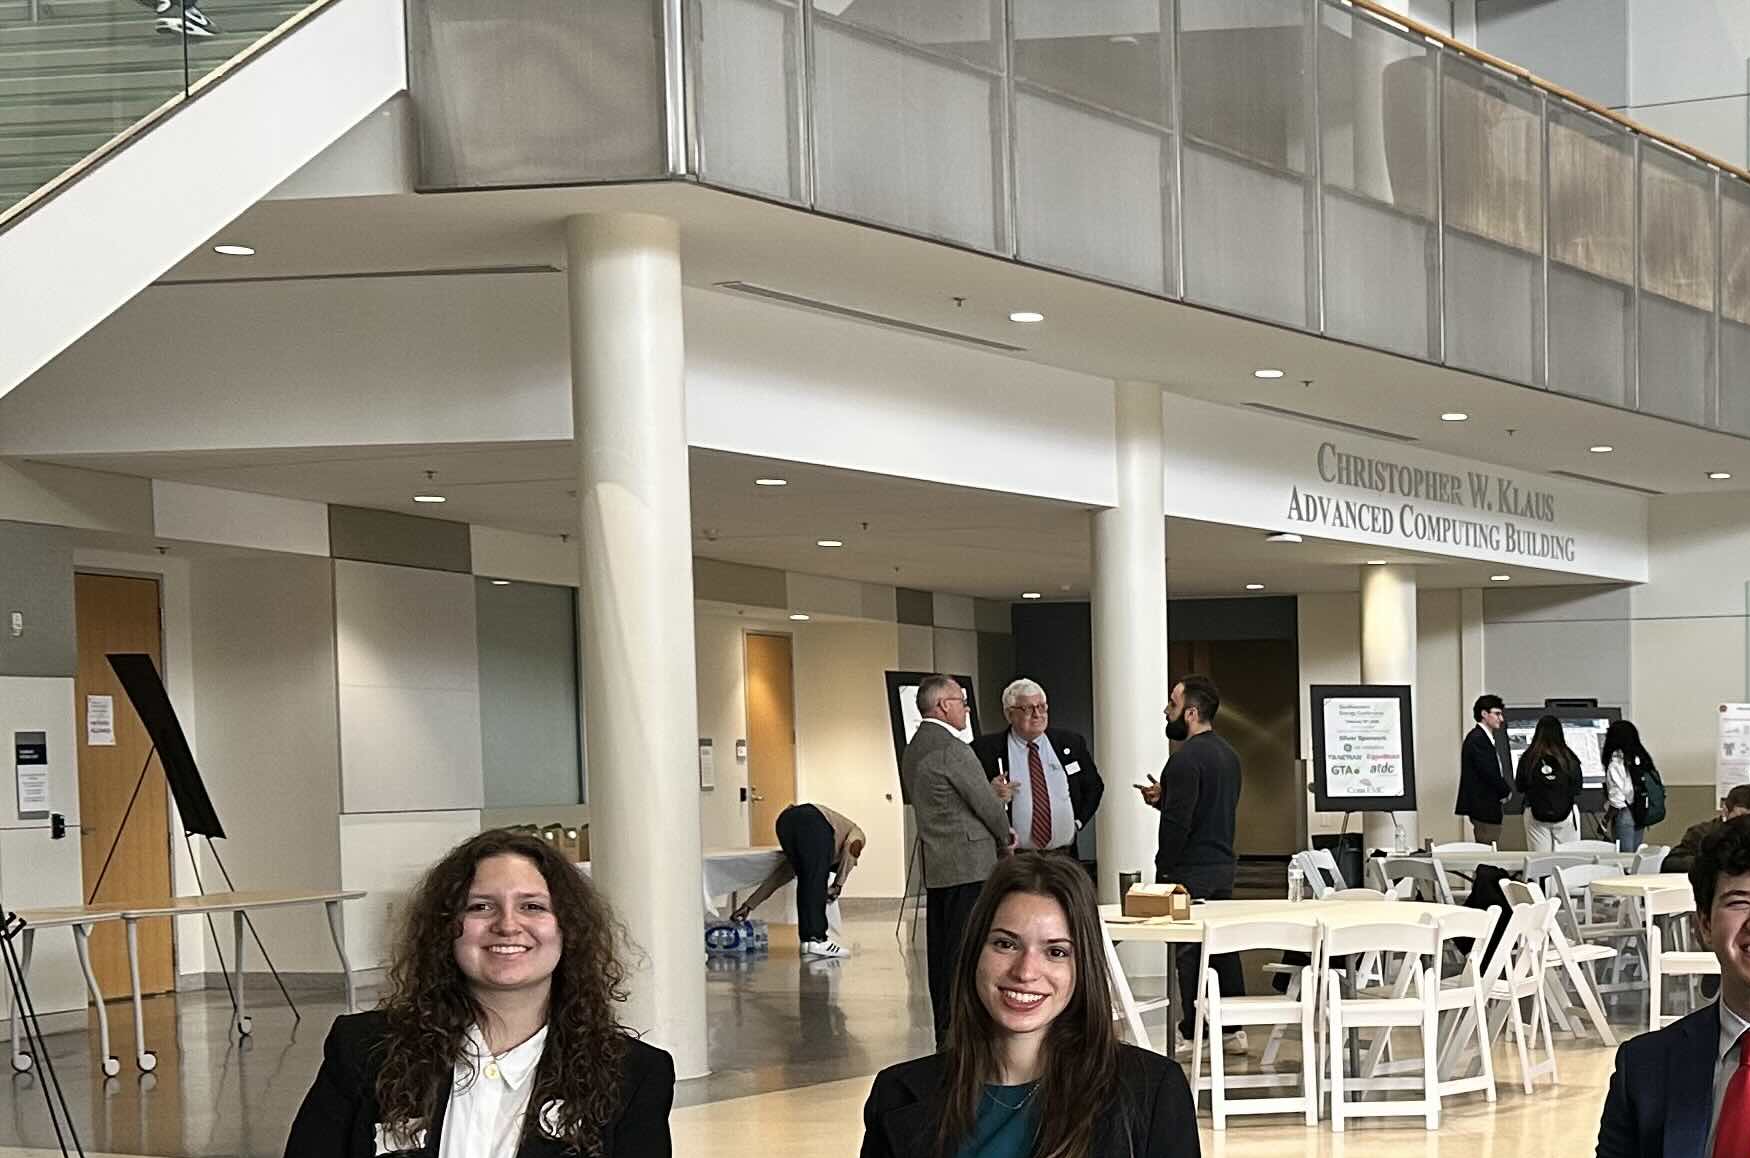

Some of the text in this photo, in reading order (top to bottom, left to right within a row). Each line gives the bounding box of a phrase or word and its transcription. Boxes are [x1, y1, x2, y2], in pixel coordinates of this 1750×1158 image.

[1317, 442, 1554, 522] CHRISTOPHER W. KLAUS
[1288, 485, 1575, 562] ADVANCED COMPUTING BUILDING
